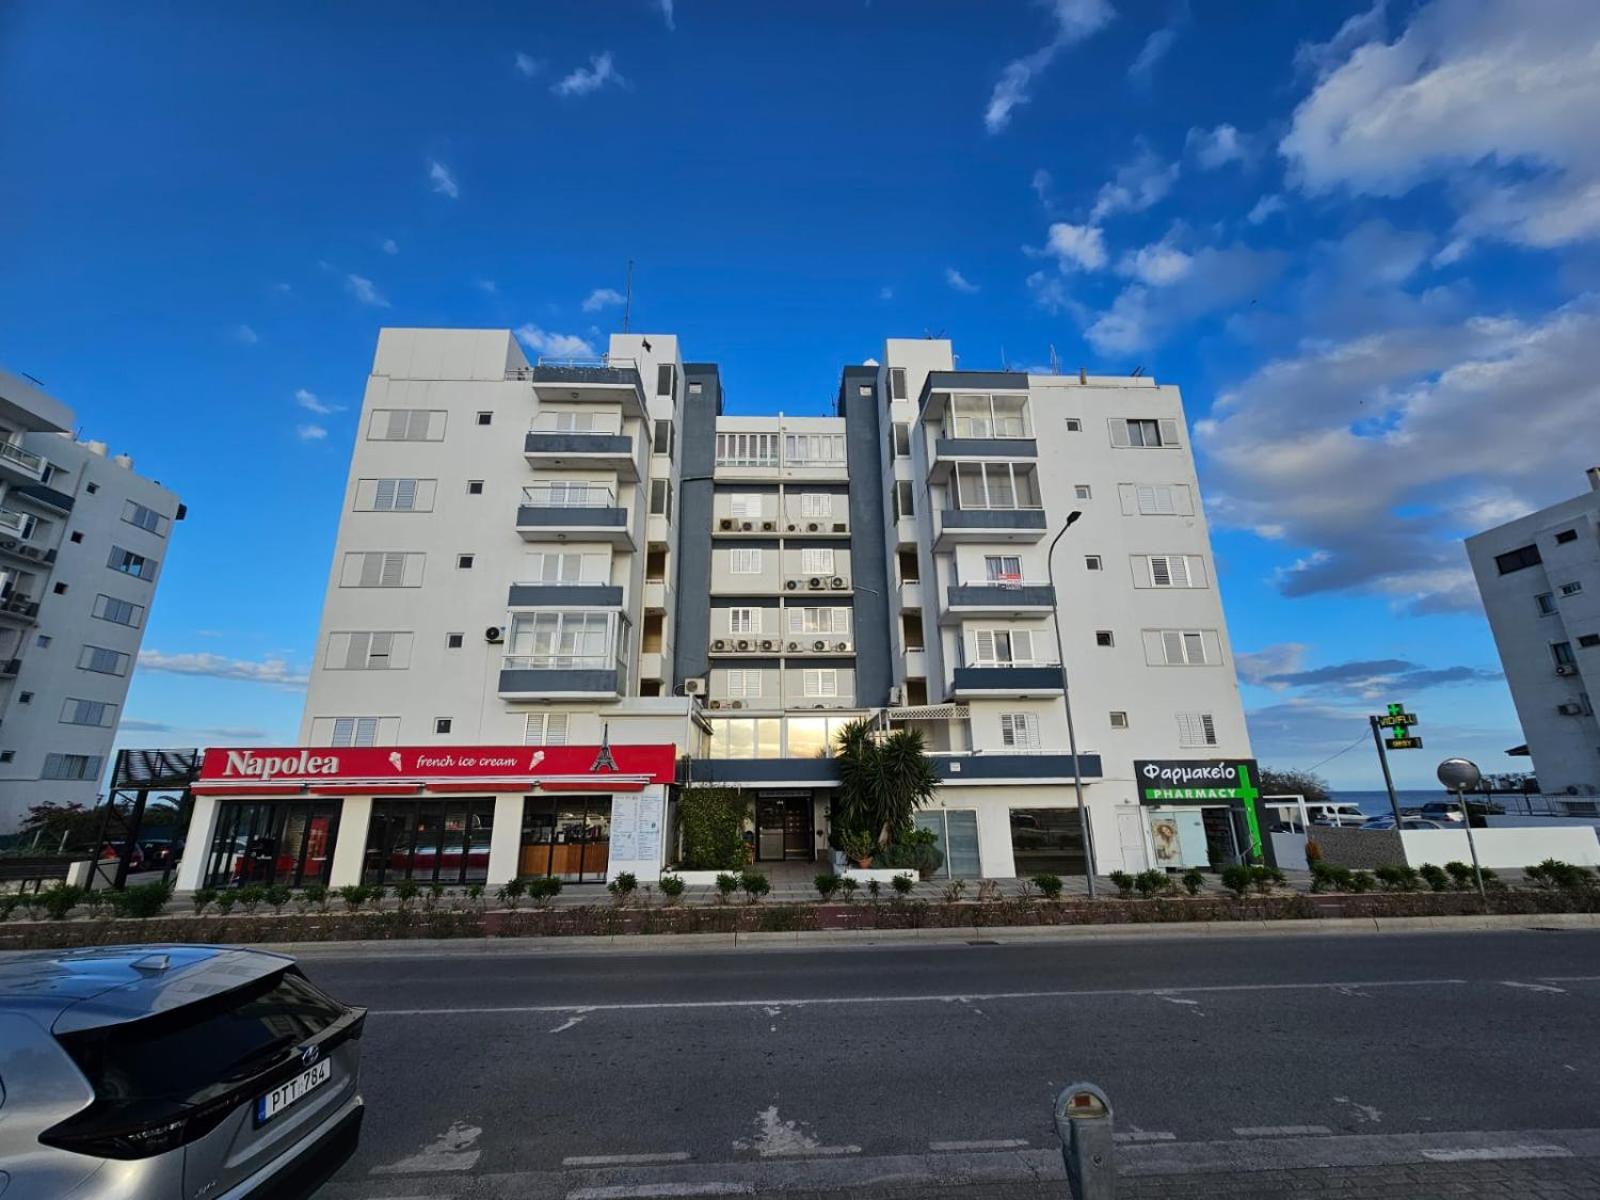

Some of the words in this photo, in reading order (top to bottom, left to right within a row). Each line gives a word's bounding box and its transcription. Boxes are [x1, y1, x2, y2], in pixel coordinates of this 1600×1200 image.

[222, 750, 340, 780] Napolea
[416, 754, 456, 769] french
[458, 755, 477, 767] ice
[479, 756, 518, 767] cream
[1143, 762, 1236, 785] Φαρμακείο
[1153, 788, 1237, 799] PHARMACY
[272, 1079, 298, 1113] PTT
[303, 1062, 325, 1091] 784
